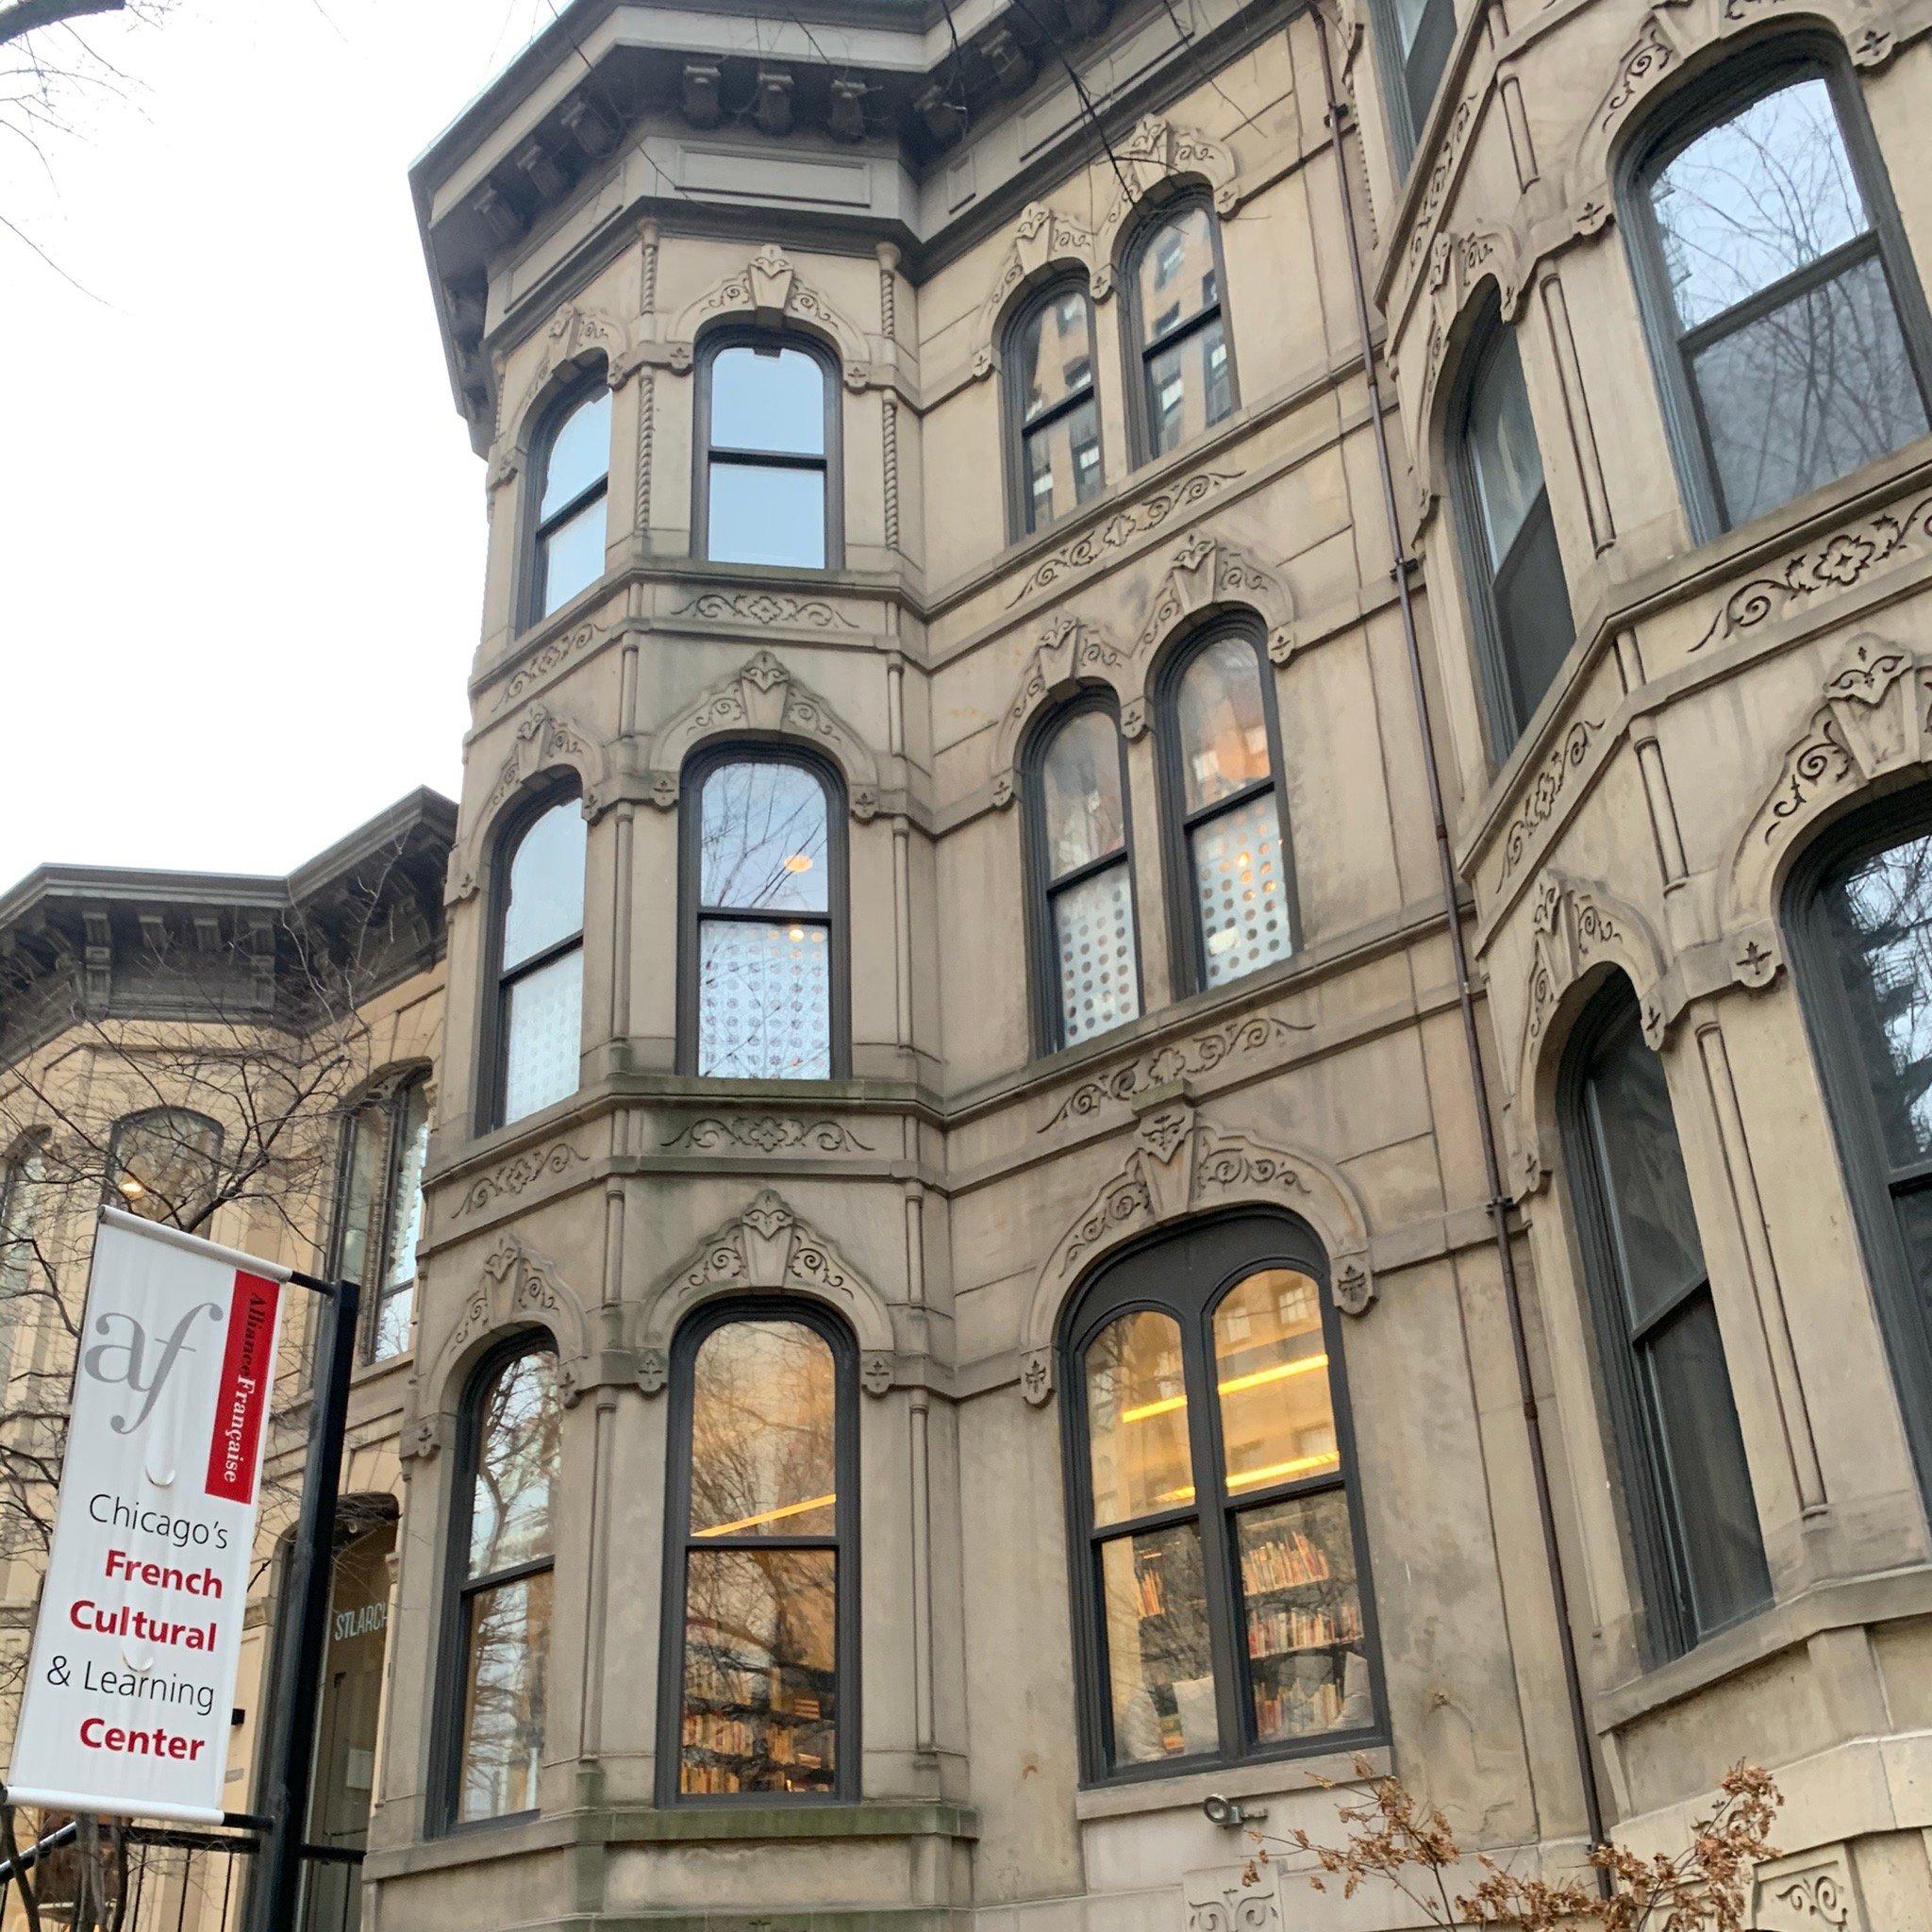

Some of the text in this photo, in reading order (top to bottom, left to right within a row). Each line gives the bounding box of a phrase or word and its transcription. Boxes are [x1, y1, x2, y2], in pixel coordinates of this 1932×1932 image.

[224, 1291, 267, 1483] Alliance Française
[90, 1493, 228, 1550] Chicago's
[105, 1550, 223, 1599] French
[70, 1601, 216, 1652] Cultural
[46, 1655, 214, 1716] & Learning
[79, 1718, 205, 1760] Center
